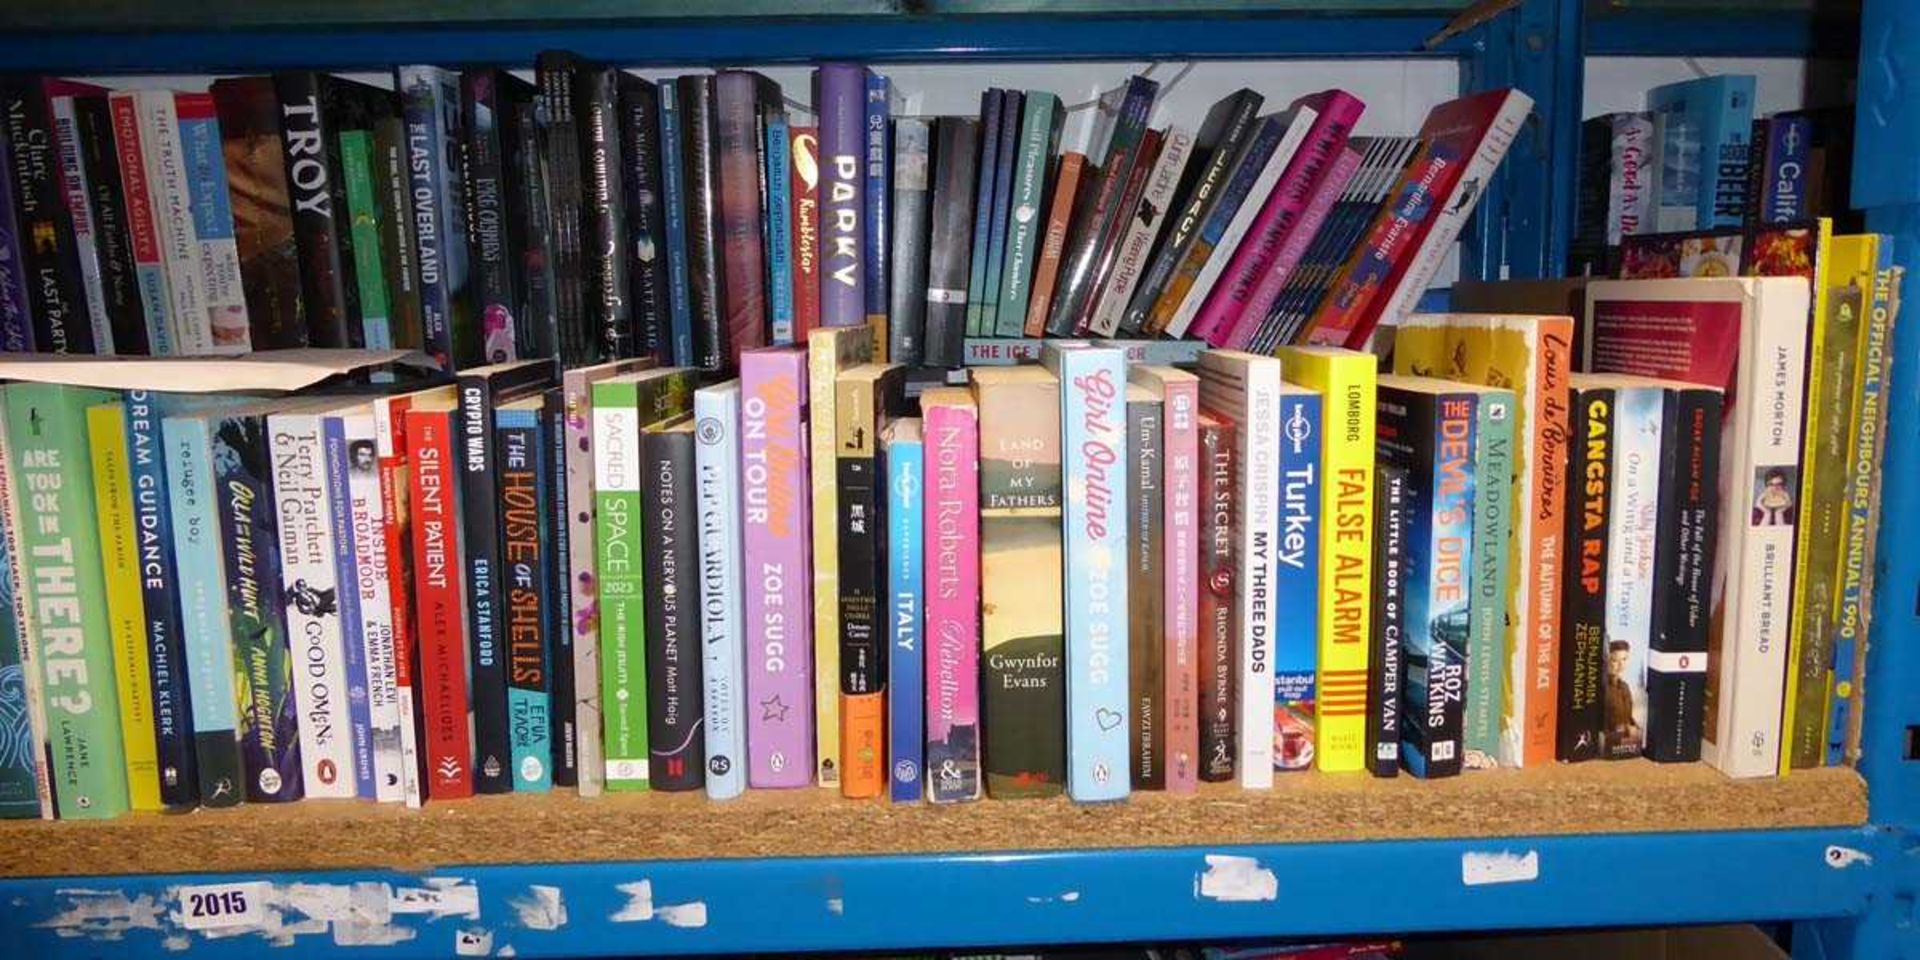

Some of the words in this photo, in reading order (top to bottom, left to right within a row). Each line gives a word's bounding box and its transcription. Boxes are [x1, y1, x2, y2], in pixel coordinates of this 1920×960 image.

[157, 109, 168, 134] THE
[193, 121, 213, 166] What
[409, 122, 426, 134] THE
[30, 128, 49, 181] Clare
[160, 141, 176, 189] TRUTH
[283, 94, 332, 220] TROY
[411, 135, 430, 182] LAST
[634, 134, 649, 185] Midnight
[1022, 142, 1039, 201] Pleasures
[120, 106, 139, 192] EMOTIONAL
[130, 199, 150, 257] AGILITY
[1170, 149, 1228, 249] LEGACY
[1399, 154, 1446, 219] Bernardine
[1715, 164, 1748, 216] BEER
[168, 195, 189, 261] MACHINE
[197, 181, 220, 234] Expect
[830, 155, 858, 286] PARKY
[416, 188, 437, 284] OVERLAND
[798, 199, 815, 273] Rumblestar
[1373, 214, 1409, 263] Evaristo
[41, 268, 58, 304] LAST
[643, 268, 655, 305] MATT
[1111, 263, 1137, 297] Purple
[1871, 269, 1891, 302] THE
[48, 309, 66, 356] PARTY
[153, 316, 168, 353] DAVID
[645, 311, 657, 348] HAIG
[971, 345, 999, 358] THE
[1007, 345, 1030, 358] ICE
[1862, 308, 1887, 385] OFFICIAL
[1541, 334, 1567, 390] Louis
[1773, 346, 1788, 388] JAMES
[130, 389, 153, 465] DREAM
[464, 388, 483, 435] CRYPTO
[744, 397, 765, 442] ON
[1082, 369, 1115, 444] Girl
[1253, 390, 1271, 449] JESSA
[1345, 384, 1361, 442] LOMBORG
[1543, 396, 1565, 421] de
[1769, 391, 1786, 447] MORTON
[22, 449, 60, 467] ARE
[278, 432, 296, 447] &
[296, 431, 318, 479] Terry
[467, 437, 485, 472] WARS
[507, 433, 525, 468] THE
[605, 412, 625, 488] SACRED
[938, 426, 963, 490] Nora
[999, 440, 1045, 450] LAND
[1852, 392, 1880, 510] NEIGHBOURS
[27, 472, 61, 490] YOU
[277, 452, 299, 494] Neil
[419, 447, 442, 516] SILENT
[659, 460, 673, 506] NOTES
[701, 465, 720, 506] PEP
[746, 448, 768, 523] TOUR
[1010, 478, 1036, 487] MY
[1011, 460, 1032, 468] OF
[1214, 448, 1230, 488] THE
[1439, 419, 1471, 525] DEVIL'S
[1538, 423, 1565, 520] Bernières
[1582, 400, 1607, 531] GANGSTA
[31, 493, 61, 513] OK
[990, 494, 1056, 506] FATHERS
[1084, 444, 1113, 540] Online
[1252, 453, 1269, 523] CRISPIN
[1334, 469, 1365, 541] FALSE
[1390, 478, 1401, 504] THE
[39, 514, 60, 533] IN
[138, 475, 163, 589] GUIDANCE
[281, 499, 303, 565] Gaiman
[302, 486, 324, 565] Pratchett
[502, 471, 538, 562] HOUSE
[605, 498, 629, 572] SPACE
[661, 510, 674, 530] ON
[1214, 492, 1230, 557] SECRET
[1279, 464, 1312, 568] Turkey
[1387, 509, 1400, 554] LITTLE
[1479, 439, 1505, 598] MEADOWLAND
[1692, 526, 1704, 541] Fall
[1693, 509, 1705, 523] The
[357, 498, 377, 600] BROADMOOR
[371, 517, 389, 581] INSIDE
[423, 521, 446, 588] PATIENT
[662, 534, 675, 546] A
[939, 499, 964, 598] Roberts
[1252, 531, 1268, 561] MY
[1541, 535, 1555, 561] THE
[1691, 543, 1703, 553] of
[1691, 554, 1701, 565] the
[1844, 514, 1869, 589] ANNUAL
[473, 558, 490, 597] ERICA
[513, 562, 533, 588] OF
[604, 582, 633, 593] 2023
[662, 549, 677, 612] NERVOUS
[703, 511, 725, 645] GUARDIOLA
[763, 562, 783, 609] ZOE
[1386, 561, 1398, 597] BOOK
[1438, 539, 1468, 602] DICE
[1580, 539, 1601, 595] RAP
[1689, 567, 1701, 593] House
[1759, 543, 1776, 608] BRILLIANT
[1251, 565, 1267, 622] THREE
[1332, 554, 1363, 645] ALARM
[1385, 602, 1397, 619] OF
[1539, 563, 1555, 621] AUTUMN
[1687, 603, 1700, 628] Usher
[1688, 593, 1700, 602] of
[33, 537, 91, 715] THERE?
[365, 620, 378, 629] &
[434, 600, 447, 638] ALEX
[476, 601, 494, 666] STANFORD
[509, 587, 543, 683] SHELLS
[664, 616, 679, 662] PLANET
[896, 592, 914, 650] ITALY
[1216, 607, 1227, 662] RHONDA
[1538, 624, 1552, 641] OF
[1757, 612, 1773, 654] BREAD
[1838, 594, 1860, 639] 1990
[152, 621, 168, 685] MACHIEL
[366, 631, 381, 666] EMMA
[380, 621, 396, 677] JONATHAN
[764, 613, 785, 673] SUGG
[988, 655, 1059, 669] Gwynfor
[1250, 625, 1267, 673] DADS
[1383, 624, 1398, 694] CAMPER
[1537, 642, 1551, 665] THE
[1571, 622, 1588, 710] ZEPHANIAH
[1585, 626, 1599, 704] BENJAMIN
[369, 669, 385, 708] FRENCH
[383, 680, 397, 704] LEVI
[436, 642, 453, 742] MICHAELIDES
[665, 666, 679, 693] Matt
[940, 619, 963, 720] Rebellion
[1002, 674, 1049, 688] Evans
[1216, 664, 1227, 704] BYRNE
[1426, 643, 1446, 728] WATKINS
[1443, 664, 1461, 702] ROZ
[1536, 665, 1550, 689] ACE
[158, 690, 173, 736] KLERK
[663, 697, 679, 725] Haig
[1381, 698, 1396, 731] VAN
[61, 720, 77, 786] LAWRENCE
[76, 738, 90, 768] JANE
[190, 891, 248, 918] 2015
